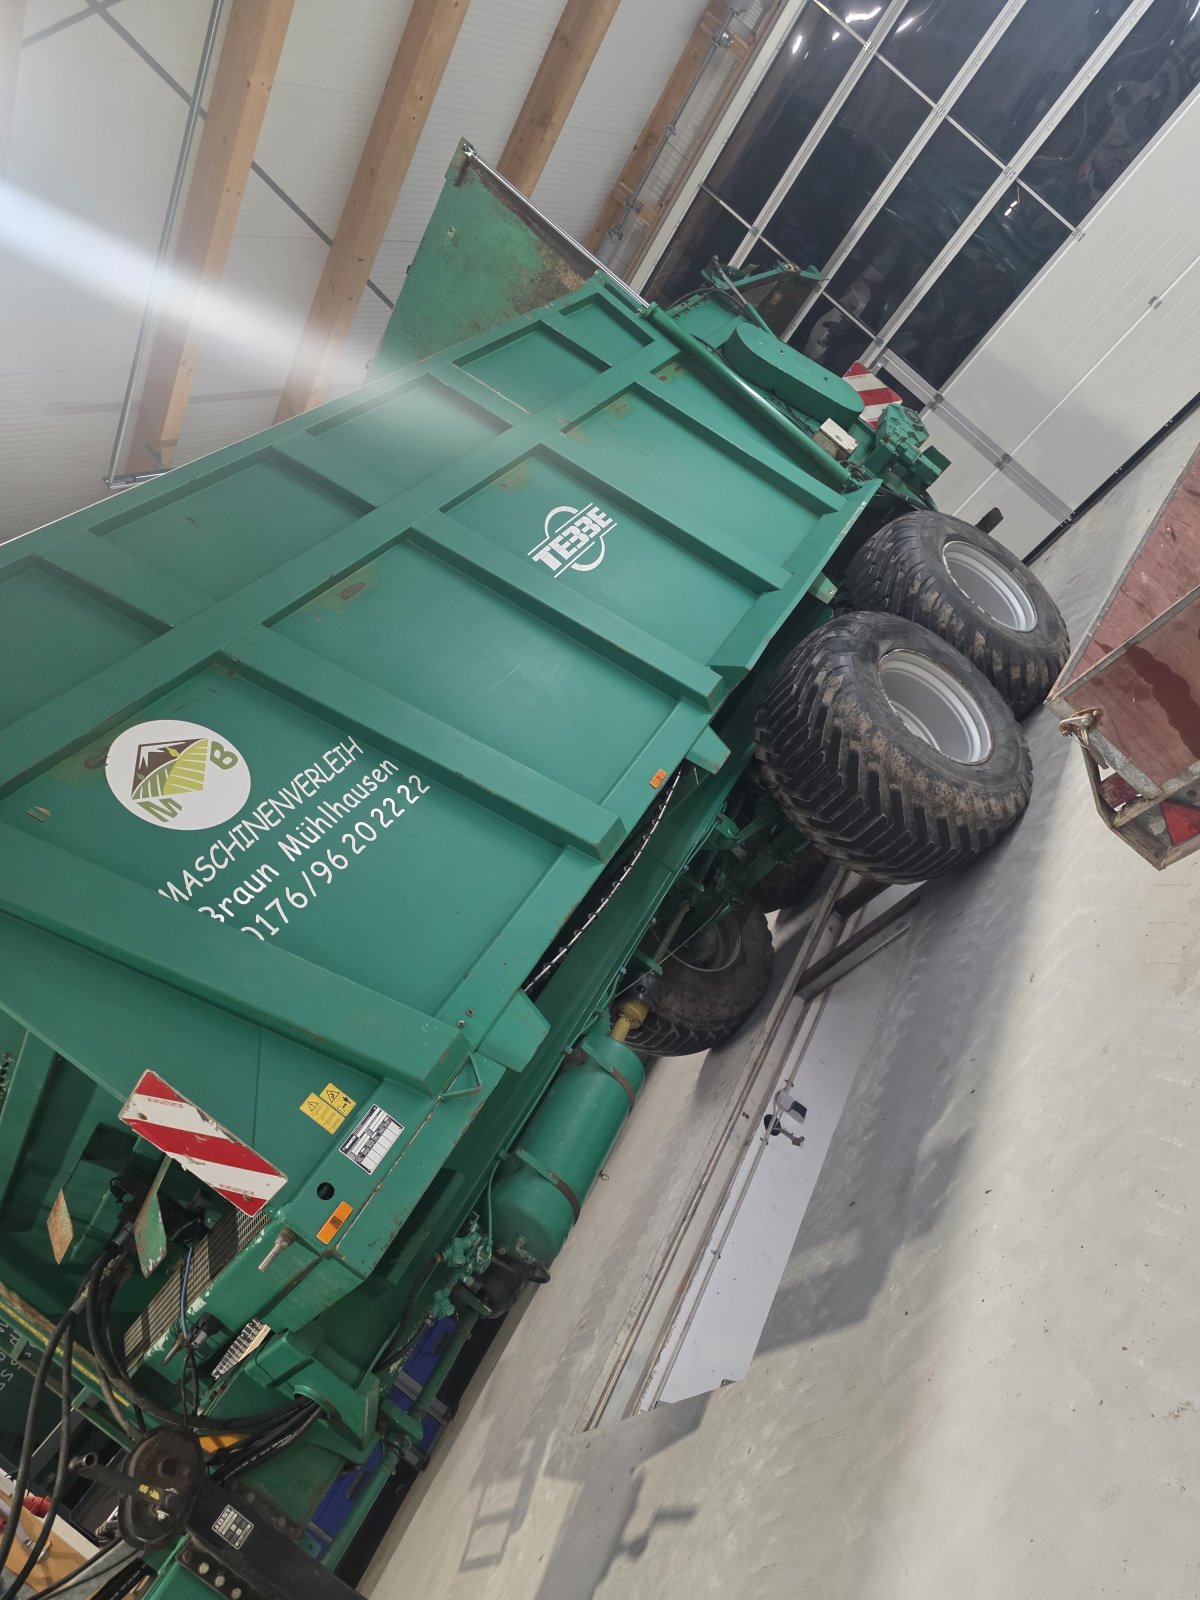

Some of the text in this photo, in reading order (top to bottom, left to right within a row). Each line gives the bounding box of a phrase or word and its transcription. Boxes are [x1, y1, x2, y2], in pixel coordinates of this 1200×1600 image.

[136, 741, 239, 823] M B
[157, 735, 364, 903] MASCHINENVERLEIH
[277, 758, 400, 862] Mühlhausen
